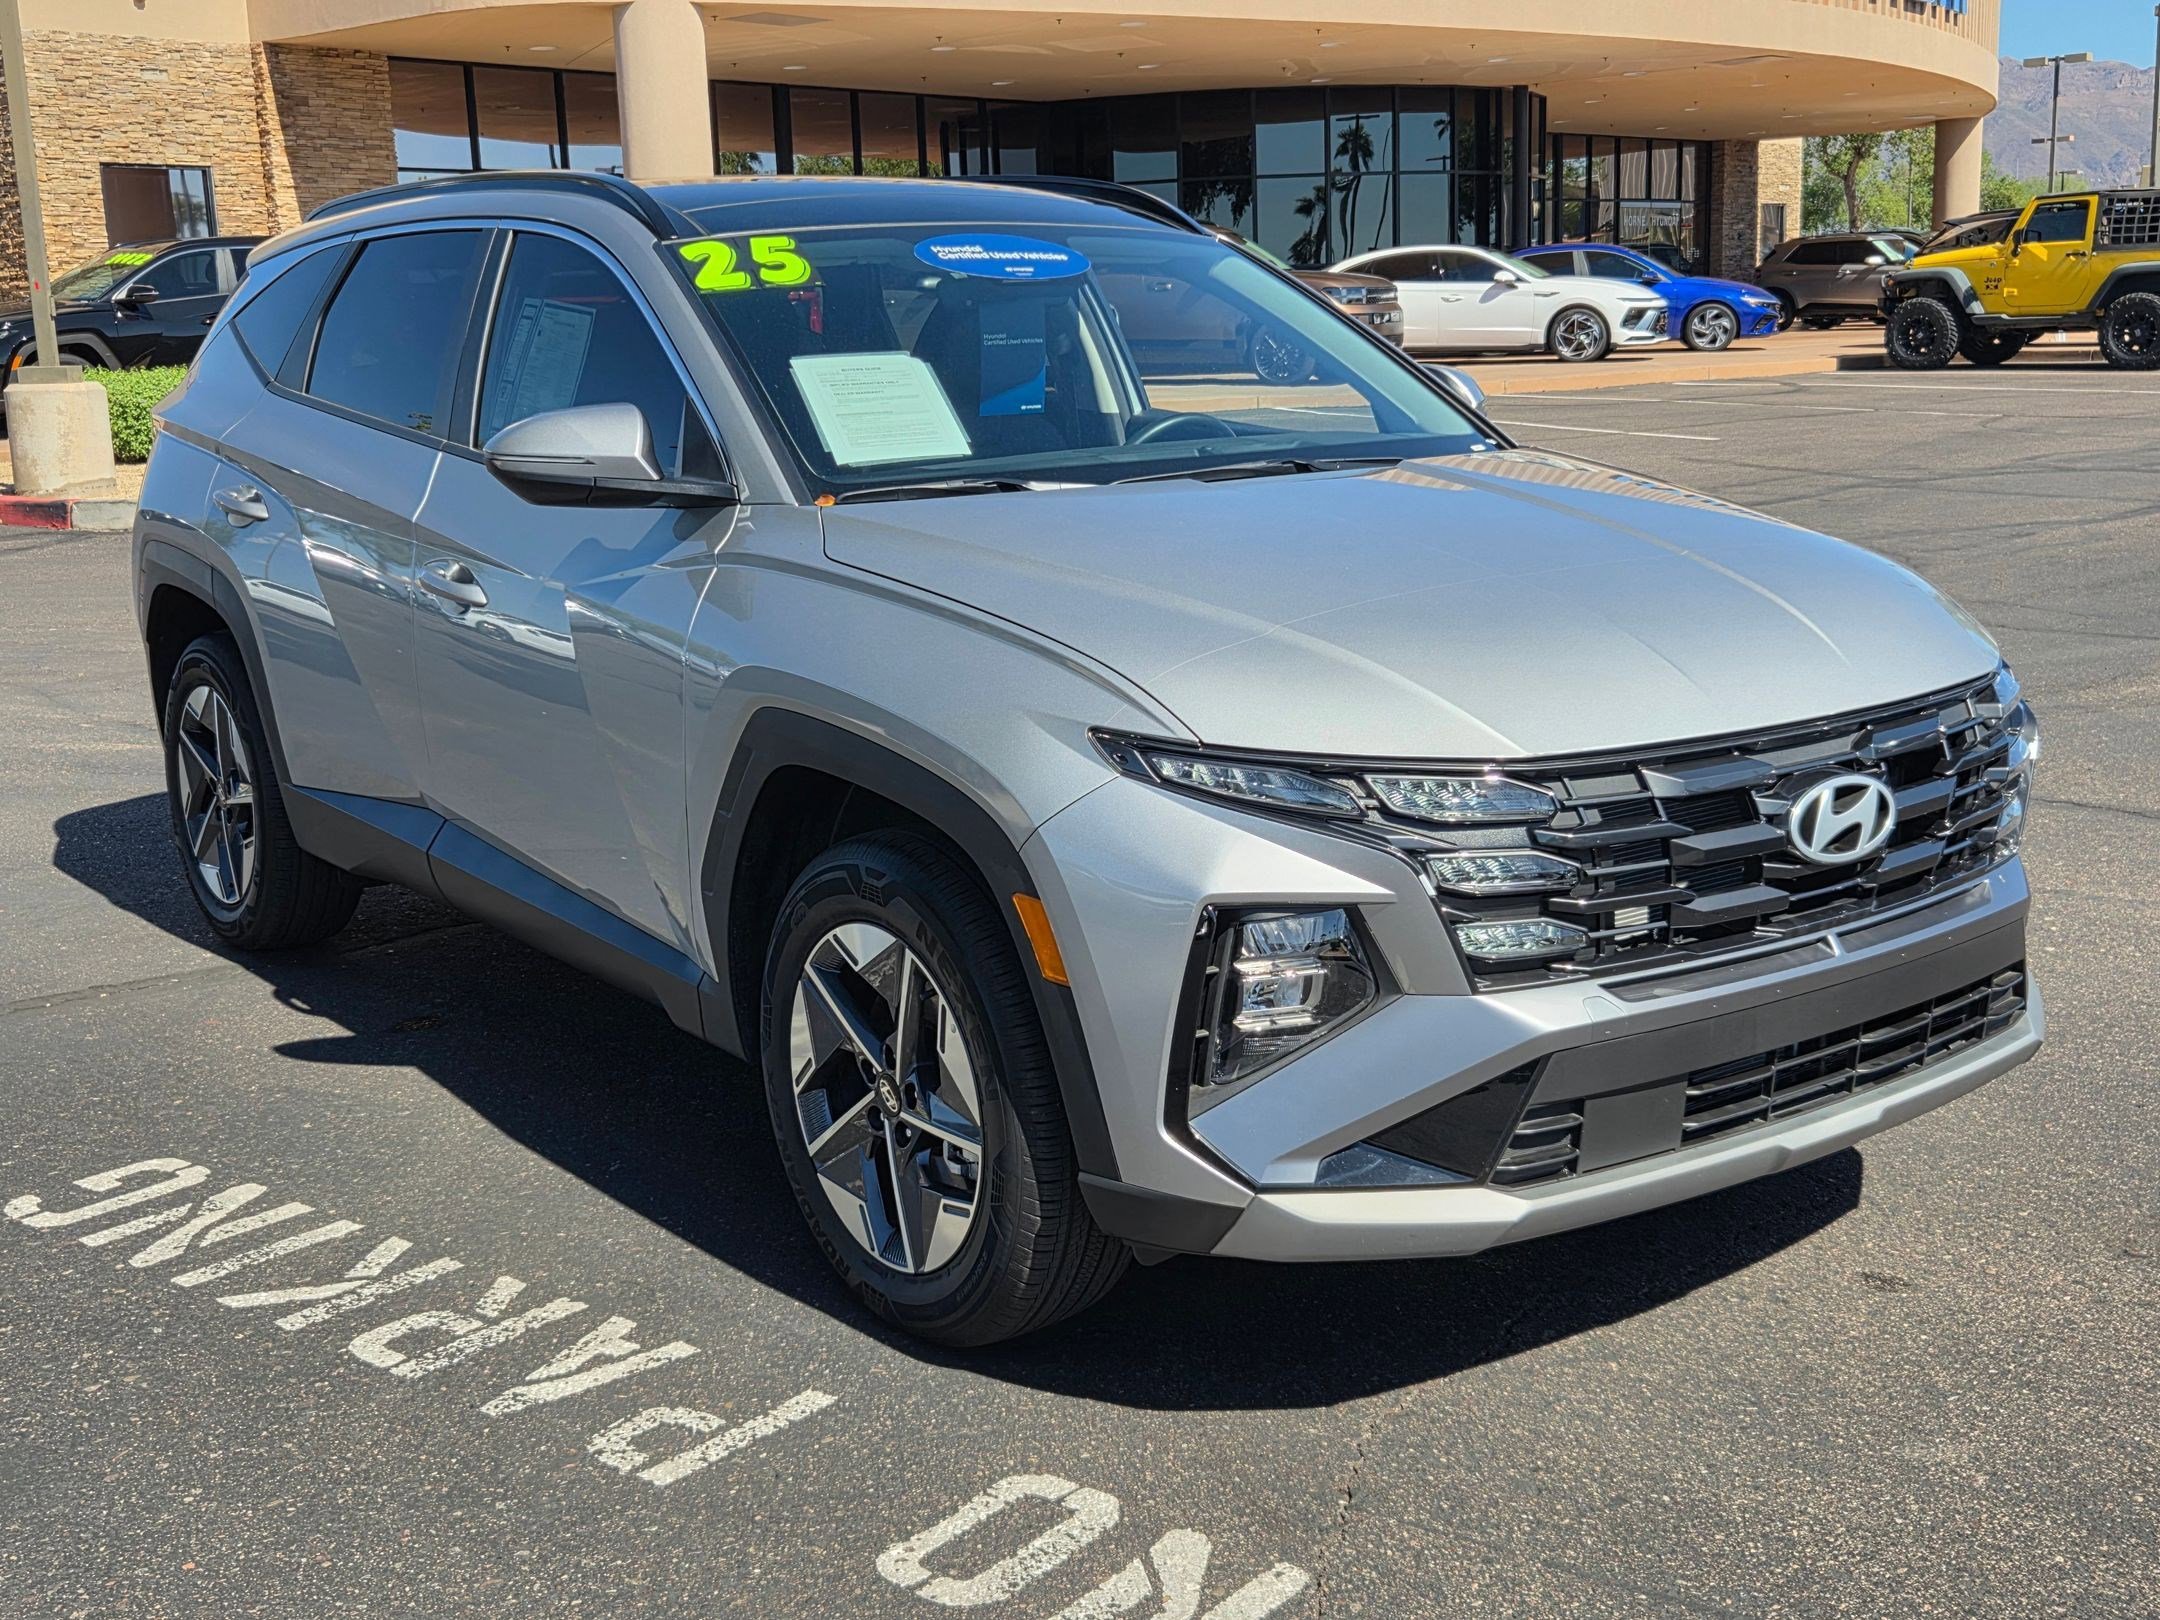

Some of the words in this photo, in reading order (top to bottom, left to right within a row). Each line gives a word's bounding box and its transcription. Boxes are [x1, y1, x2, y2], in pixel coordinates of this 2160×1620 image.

[1623, 215, 1646, 226] HORNE
[1651, 215, 1680, 226] HYUNDAI
[930, 245, 983, 255] Hyundai
[1019, 253, 1068, 261] Vehicles
[679, 236, 812, 291] 25
[3, 1157, 838, 1486] PARKING
